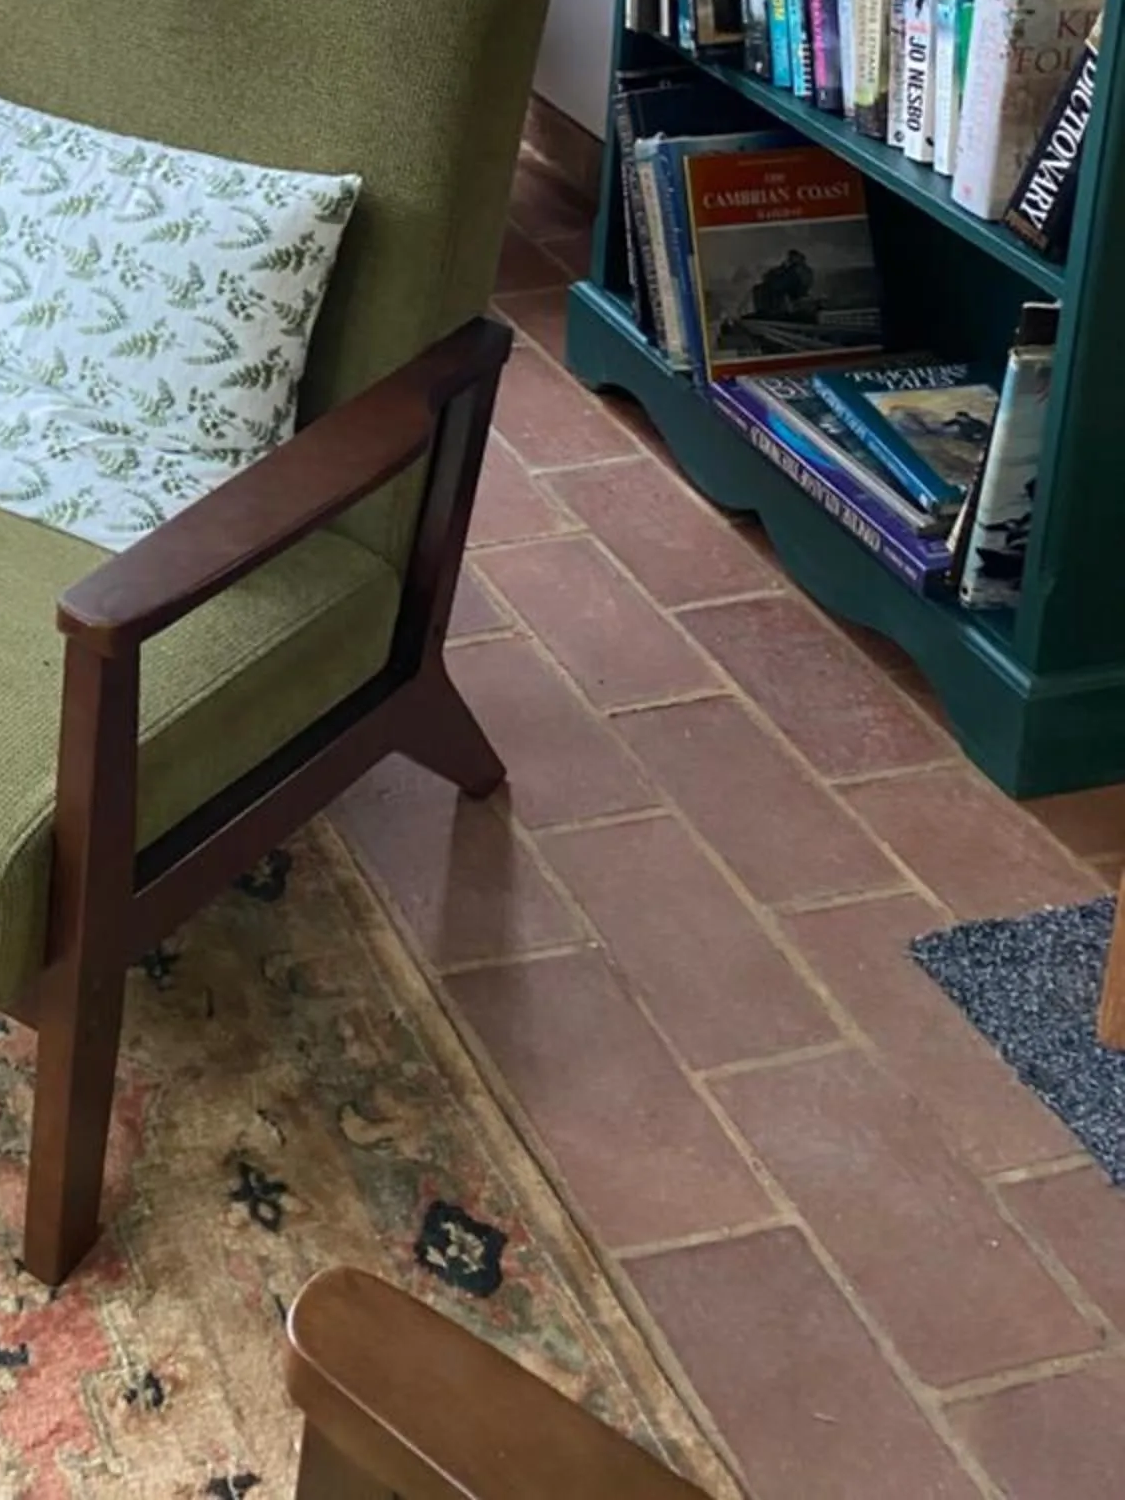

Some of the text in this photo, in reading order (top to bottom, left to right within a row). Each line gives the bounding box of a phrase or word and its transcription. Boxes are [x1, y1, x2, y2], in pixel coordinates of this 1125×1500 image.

[906, 35, 927, 133] JO NESBO
[1020, 58, 1097, 230] DICTIONARY
[703, 182, 851, 210] CAMBRIAN COAST
